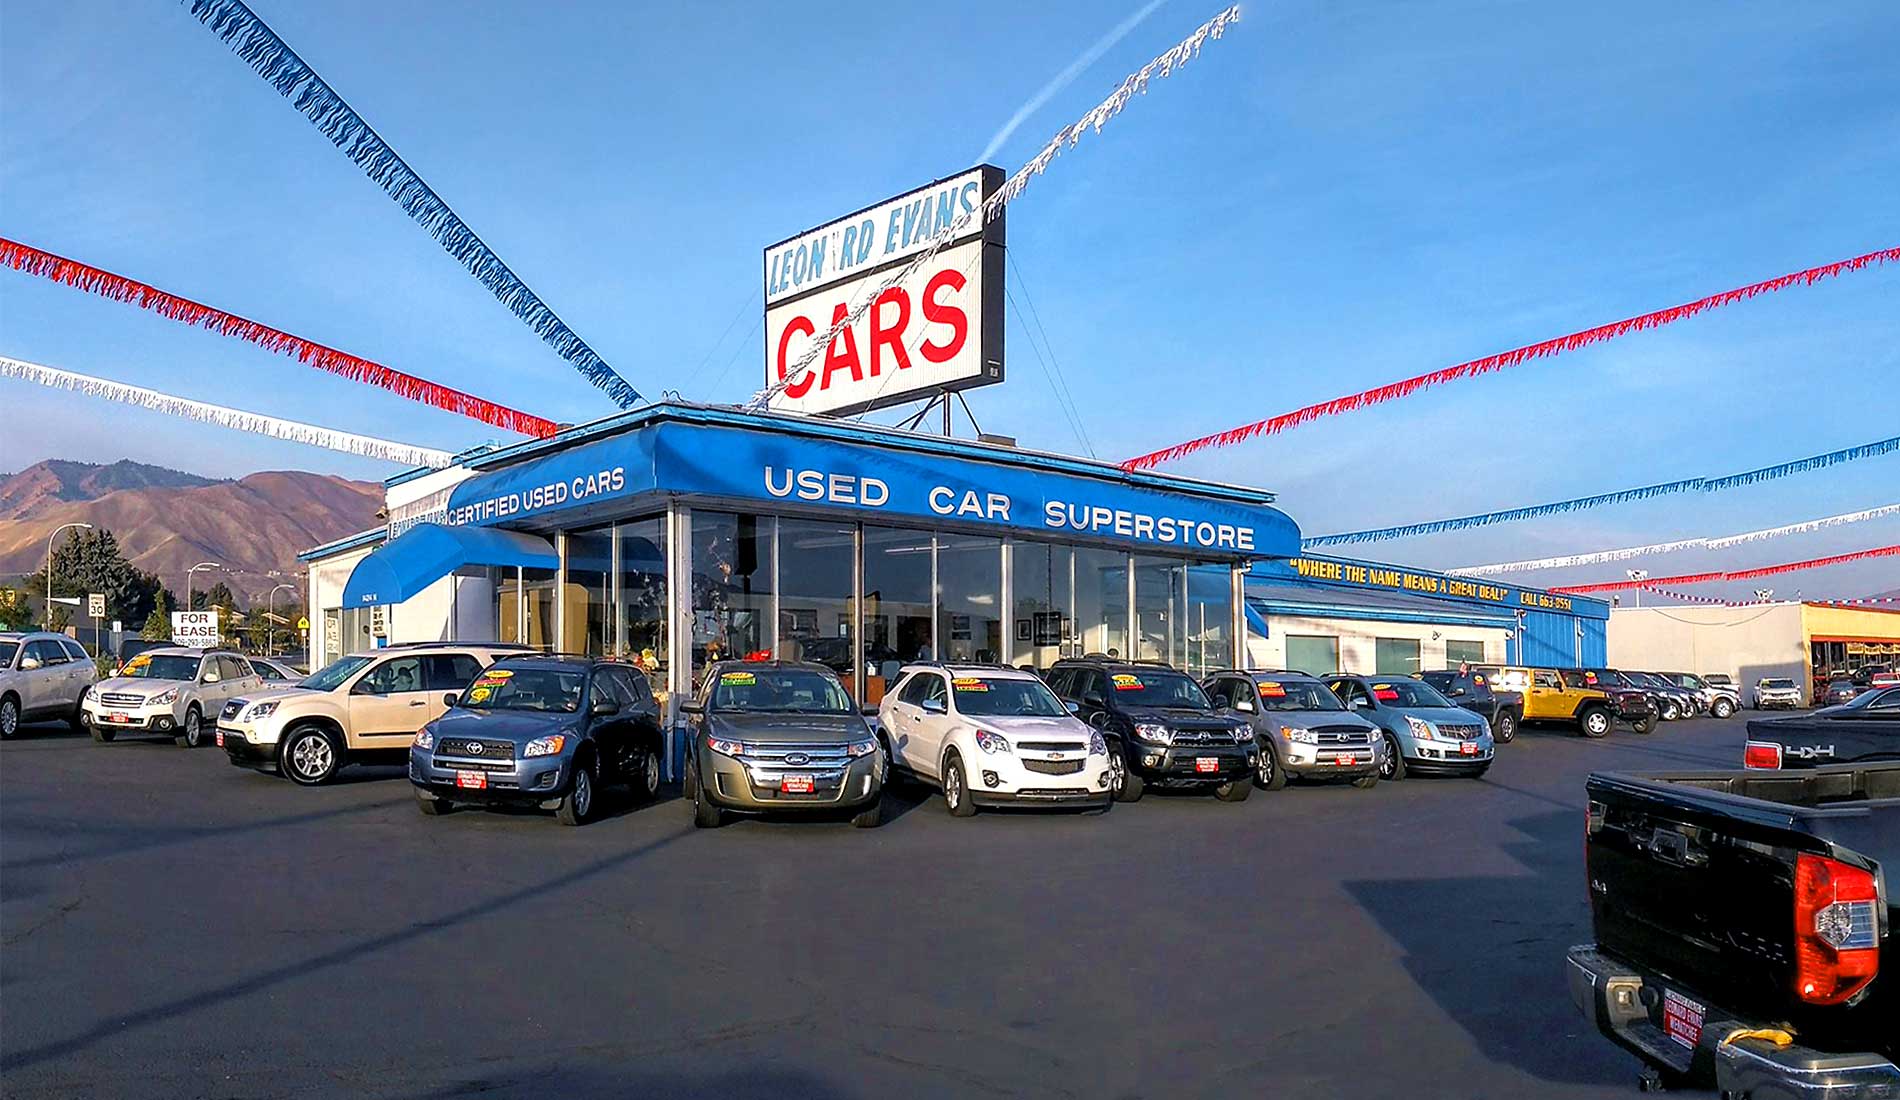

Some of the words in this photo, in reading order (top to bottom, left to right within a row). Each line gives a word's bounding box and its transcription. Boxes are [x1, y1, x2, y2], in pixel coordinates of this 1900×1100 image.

[768, 219, 875, 296] LEONRD
[883, 181, 979, 255] EVANS
[777, 268, 968, 399] CARS
[449, 494, 520, 525] CERTIFIED
[522, 482, 568, 511] USED
[572, 467, 626, 499] CARS
[764, 466, 890, 507] USED
[929, 486, 1011, 521] CAR
[1044, 500, 1256, 551] SUPERSTORE
[90, 605, 104, 614] 30
[1345, 565, 1366, 583] THE
[1369, 569, 1401, 587] NAME
[1403, 573, 1438, 592] MEANS
[1440, 579, 1447, 593] A
[1449, 580, 1477, 598] GREAT
[1520, 591, 1538, 606] CALL
[173, 626, 216, 636] LEASE
[181, 613, 208, 623] FOR
